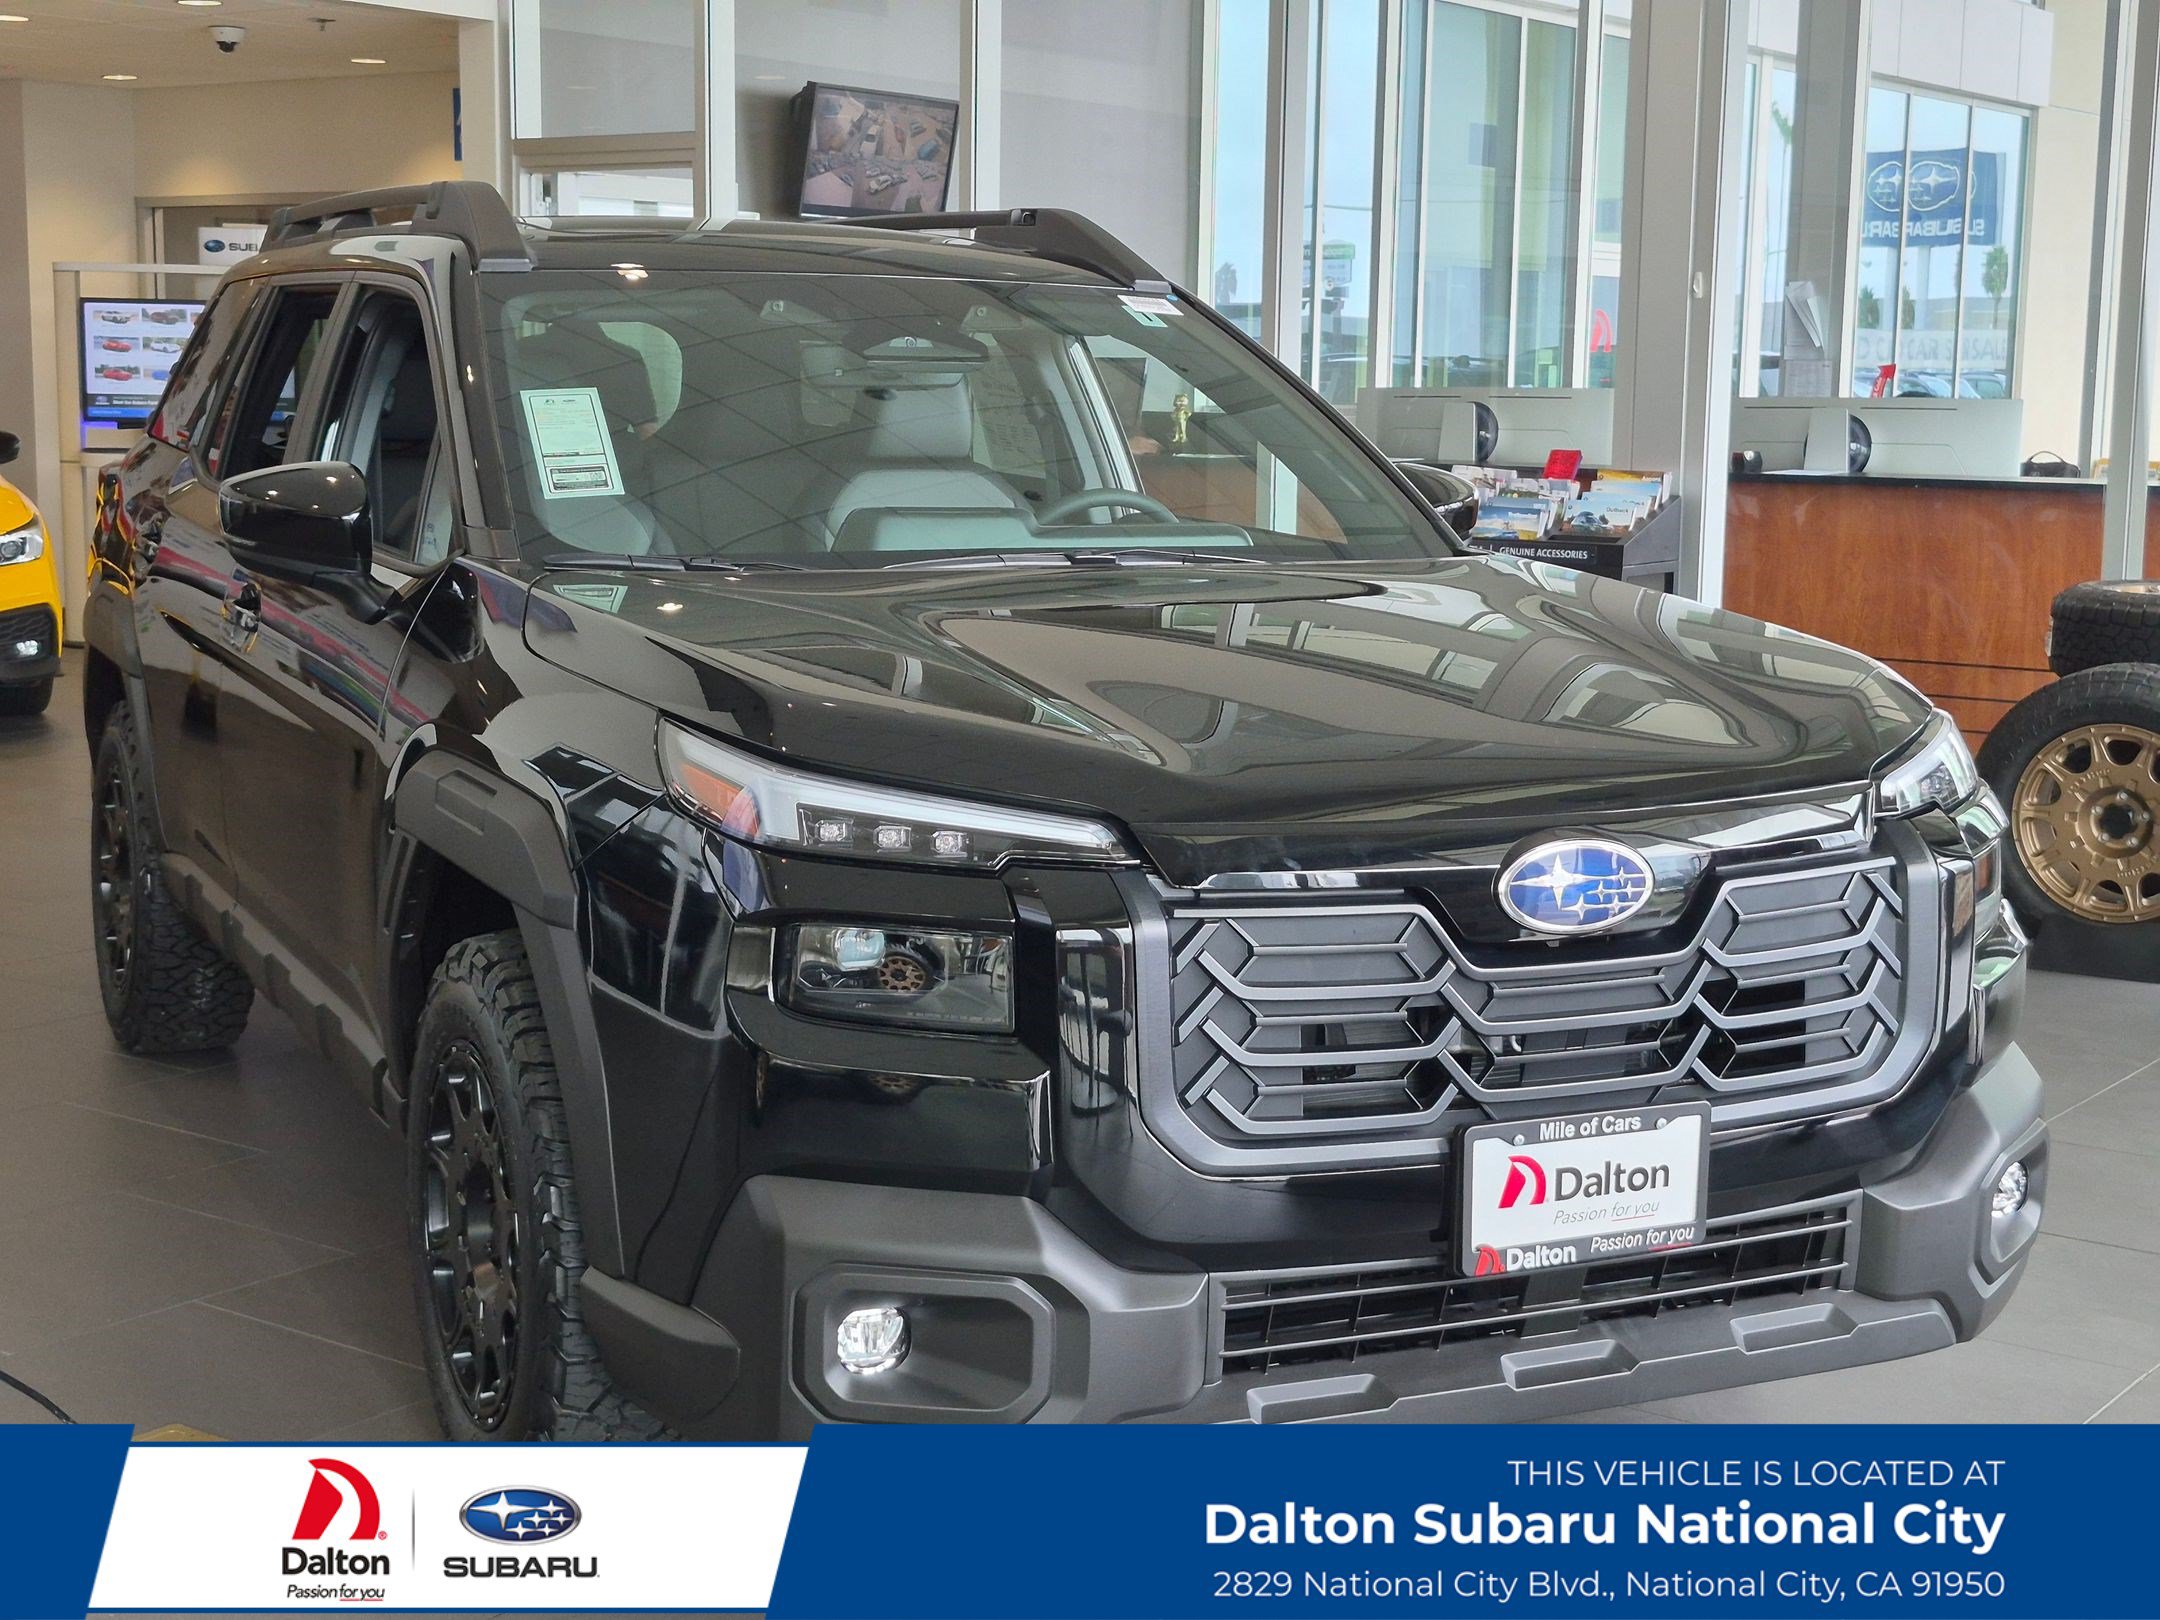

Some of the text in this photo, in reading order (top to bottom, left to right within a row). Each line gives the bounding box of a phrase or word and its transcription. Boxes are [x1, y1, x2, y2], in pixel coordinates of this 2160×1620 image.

[1499, 546, 1535, 557] GENUINE
[1536, 548, 1588, 560] ACCESSORIES
[1539, 1114, 1642, 1141] Mile of Cars
[1555, 1161, 1670, 1201] Dalton
[1553, 1200, 1660, 1225] Passion for you
[1590, 1225, 1695, 1254] Passion for you
[1506, 1243, 1577, 1271] Dalton
